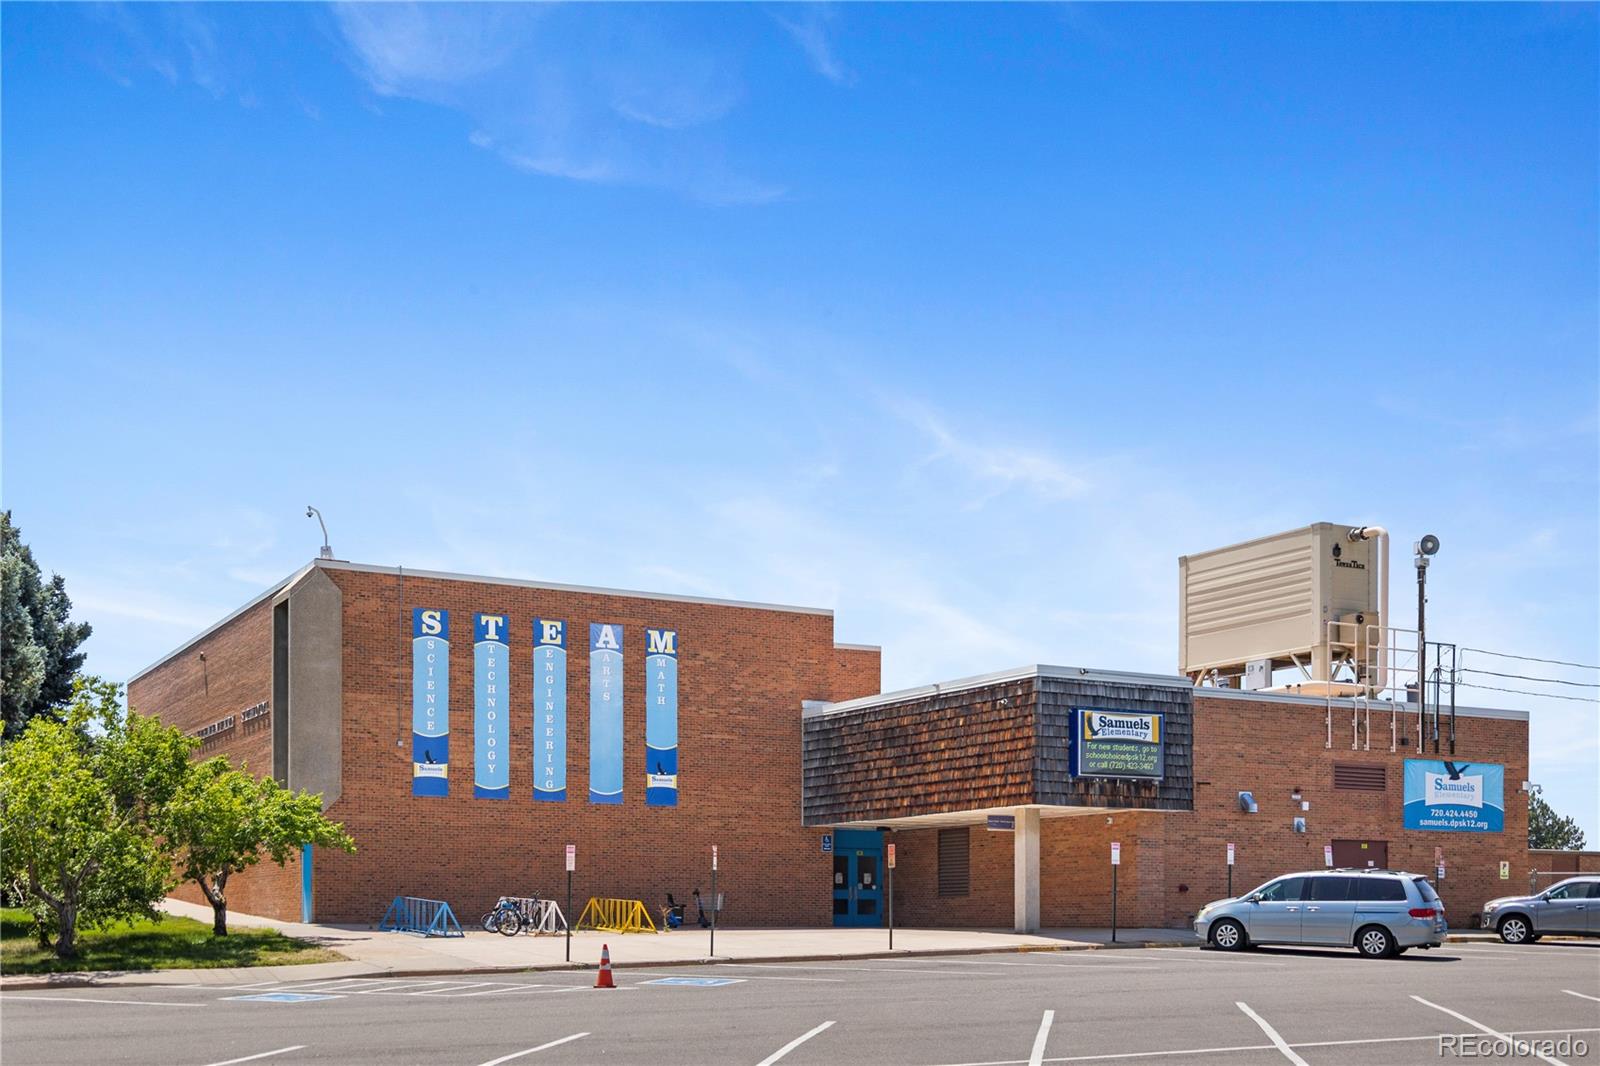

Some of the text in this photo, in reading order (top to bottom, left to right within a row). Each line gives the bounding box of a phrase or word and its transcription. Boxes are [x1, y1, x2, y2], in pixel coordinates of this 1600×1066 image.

[421, 610, 441, 635] S
[481, 615, 503, 640] T
[540, 620, 562, 644] E
[595, 624, 619, 649] A
[648, 630, 676, 654] M
[427, 639, 435, 731] SCIENCE
[602, 653, 611, 701] ARTS
[656, 658, 666, 705] MATH
[487, 645, 496, 773] TECHNOLOGY
[545, 650, 554, 789] ENGINEERING
[1098, 715, 1150, 730] Samuels
[1101, 728, 1148, 739] Elementary
[1087, 741, 1097, 750] For
[1434, 778, 1475, 792] Samuels
[1419, 819, 1488, 829] samuels.dpsk12.org
[1431, 809, 1478, 818] 720.424.4450
